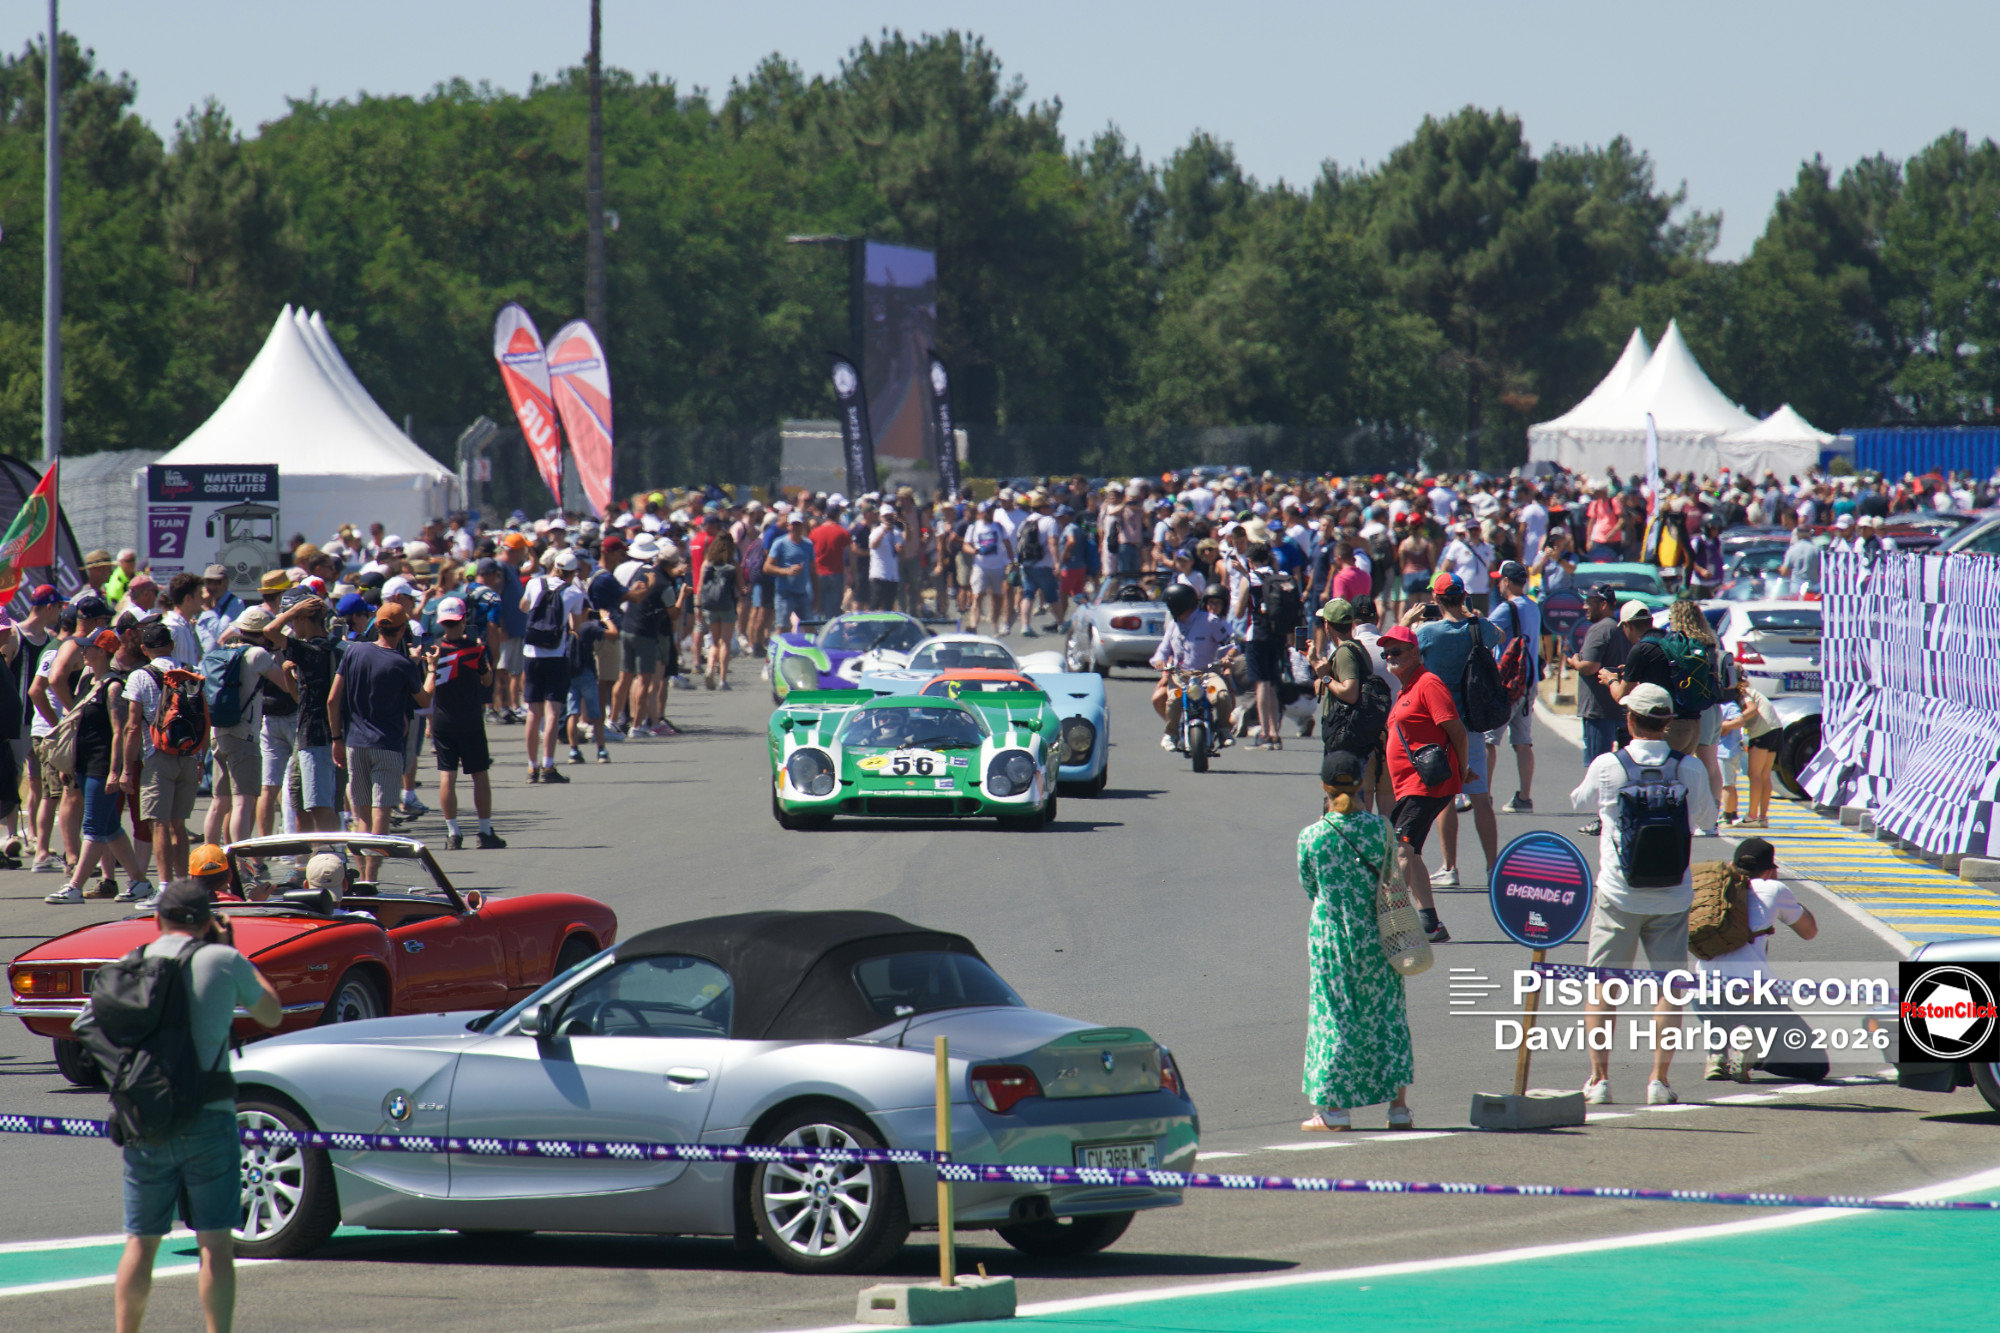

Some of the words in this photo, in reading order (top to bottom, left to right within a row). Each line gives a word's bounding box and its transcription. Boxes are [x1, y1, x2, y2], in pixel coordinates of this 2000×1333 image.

[203, 473, 267, 484] NAVETTES
[203, 484, 267, 493] GRATUITES
[152, 519, 185, 528] TRAIN
[158, 532, 177, 553] 2
[892, 756, 934, 776] 56
[1506, 883, 1562, 903] EMERAUDE
[1561, 890, 1576, 906] GT
